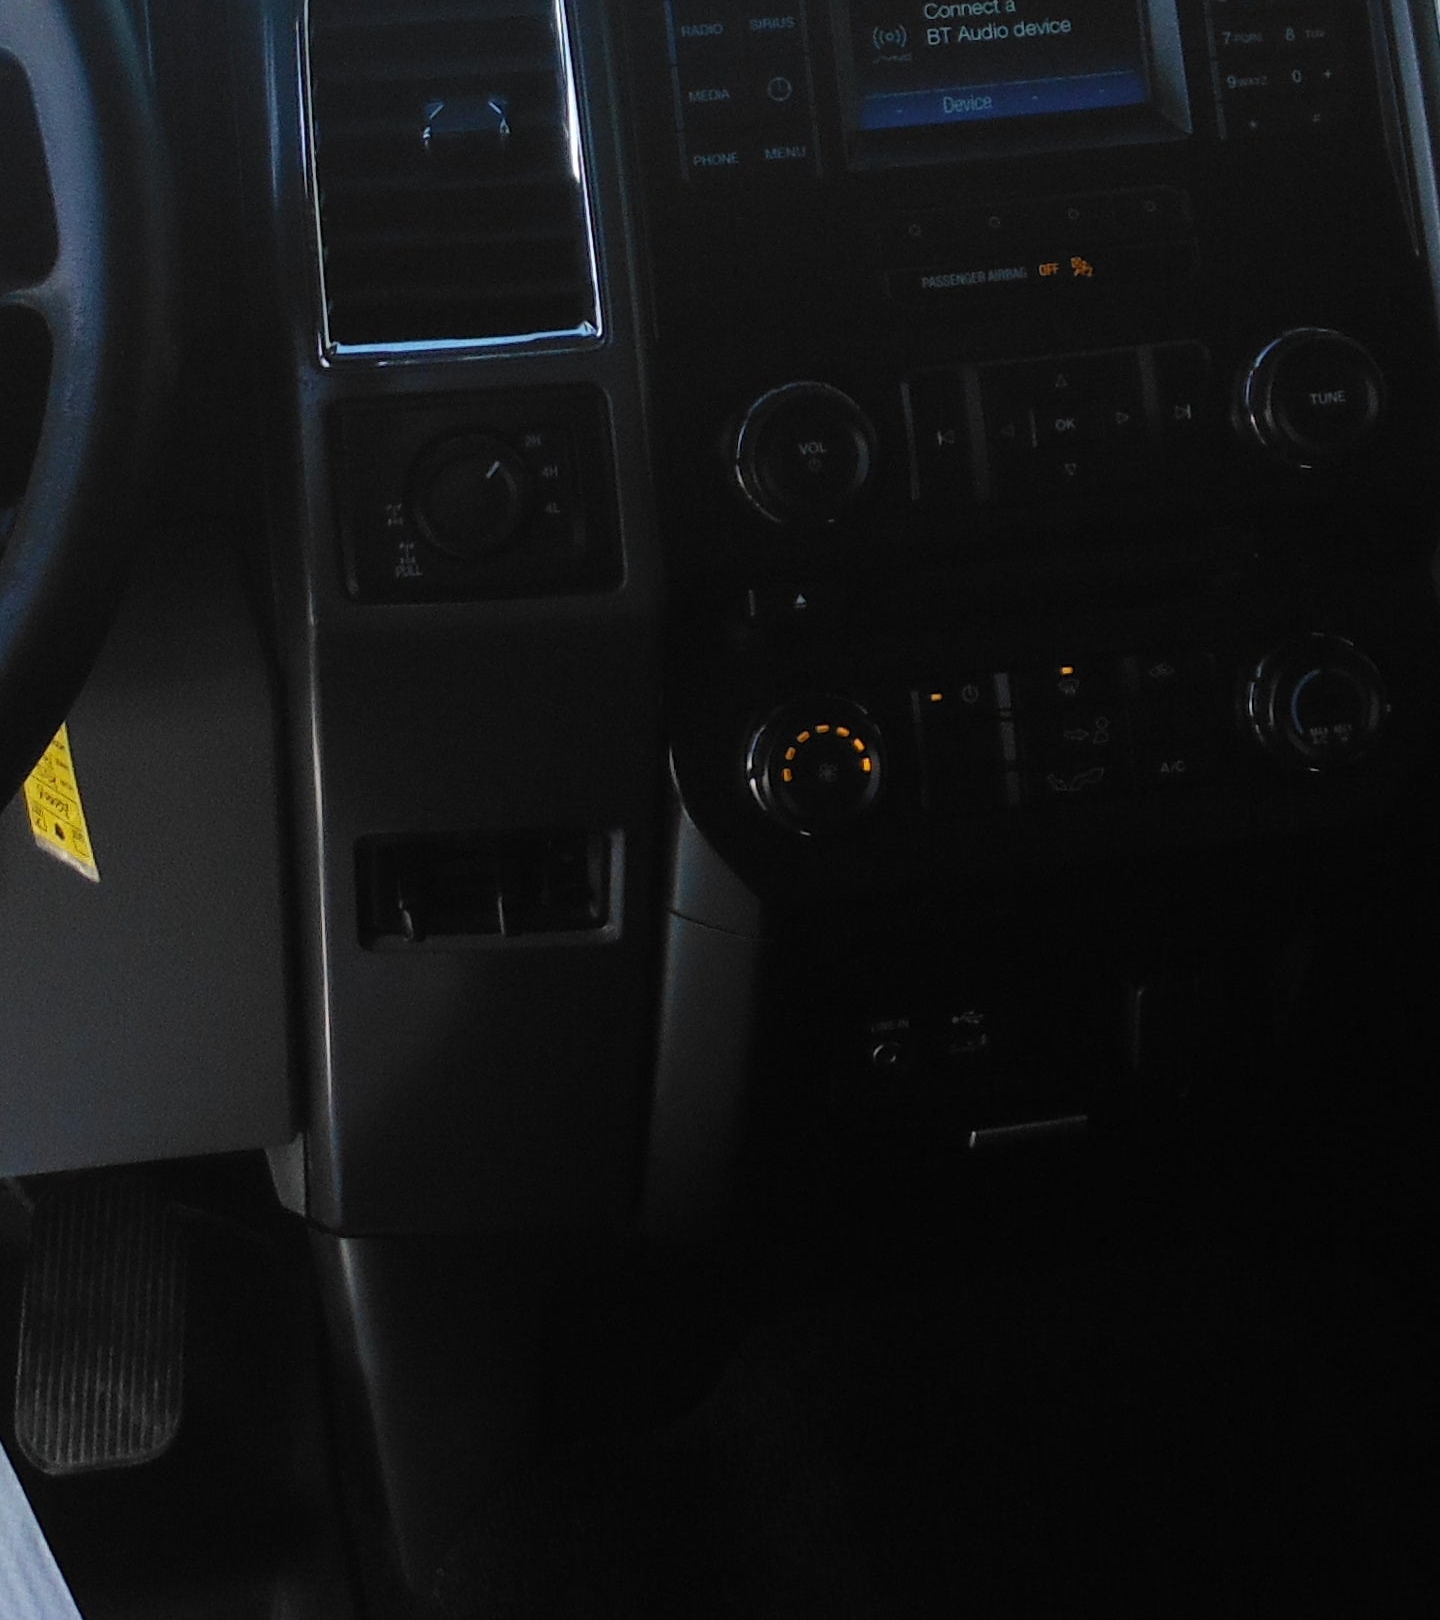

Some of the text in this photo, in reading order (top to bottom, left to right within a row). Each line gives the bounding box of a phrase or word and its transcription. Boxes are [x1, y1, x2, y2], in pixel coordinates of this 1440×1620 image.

[680, 22, 724, 38] RADIO
[748, 15, 797, 32] SIRIUS
[926, 17, 1073, 47] BT Audio device
[1284, 26, 1296, 42] 8
[1226, 74, 1237, 89] 9
[1291, 68, 1303, 84] 0
[688, 87, 732, 103] MEDIA
[942, 95, 994, 115] Device
[692, 151, 740, 168] PHONE
[764, 145, 808, 161] MENU
[920, 261, 1061, 289] PASSENGER AIRBAG OFF
[1308, 389, 1348, 405] TUNE
[1054, 418, 1077, 431] OK
[797, 440, 829, 456] VOL
[1159, 759, 1187, 774] A/C
